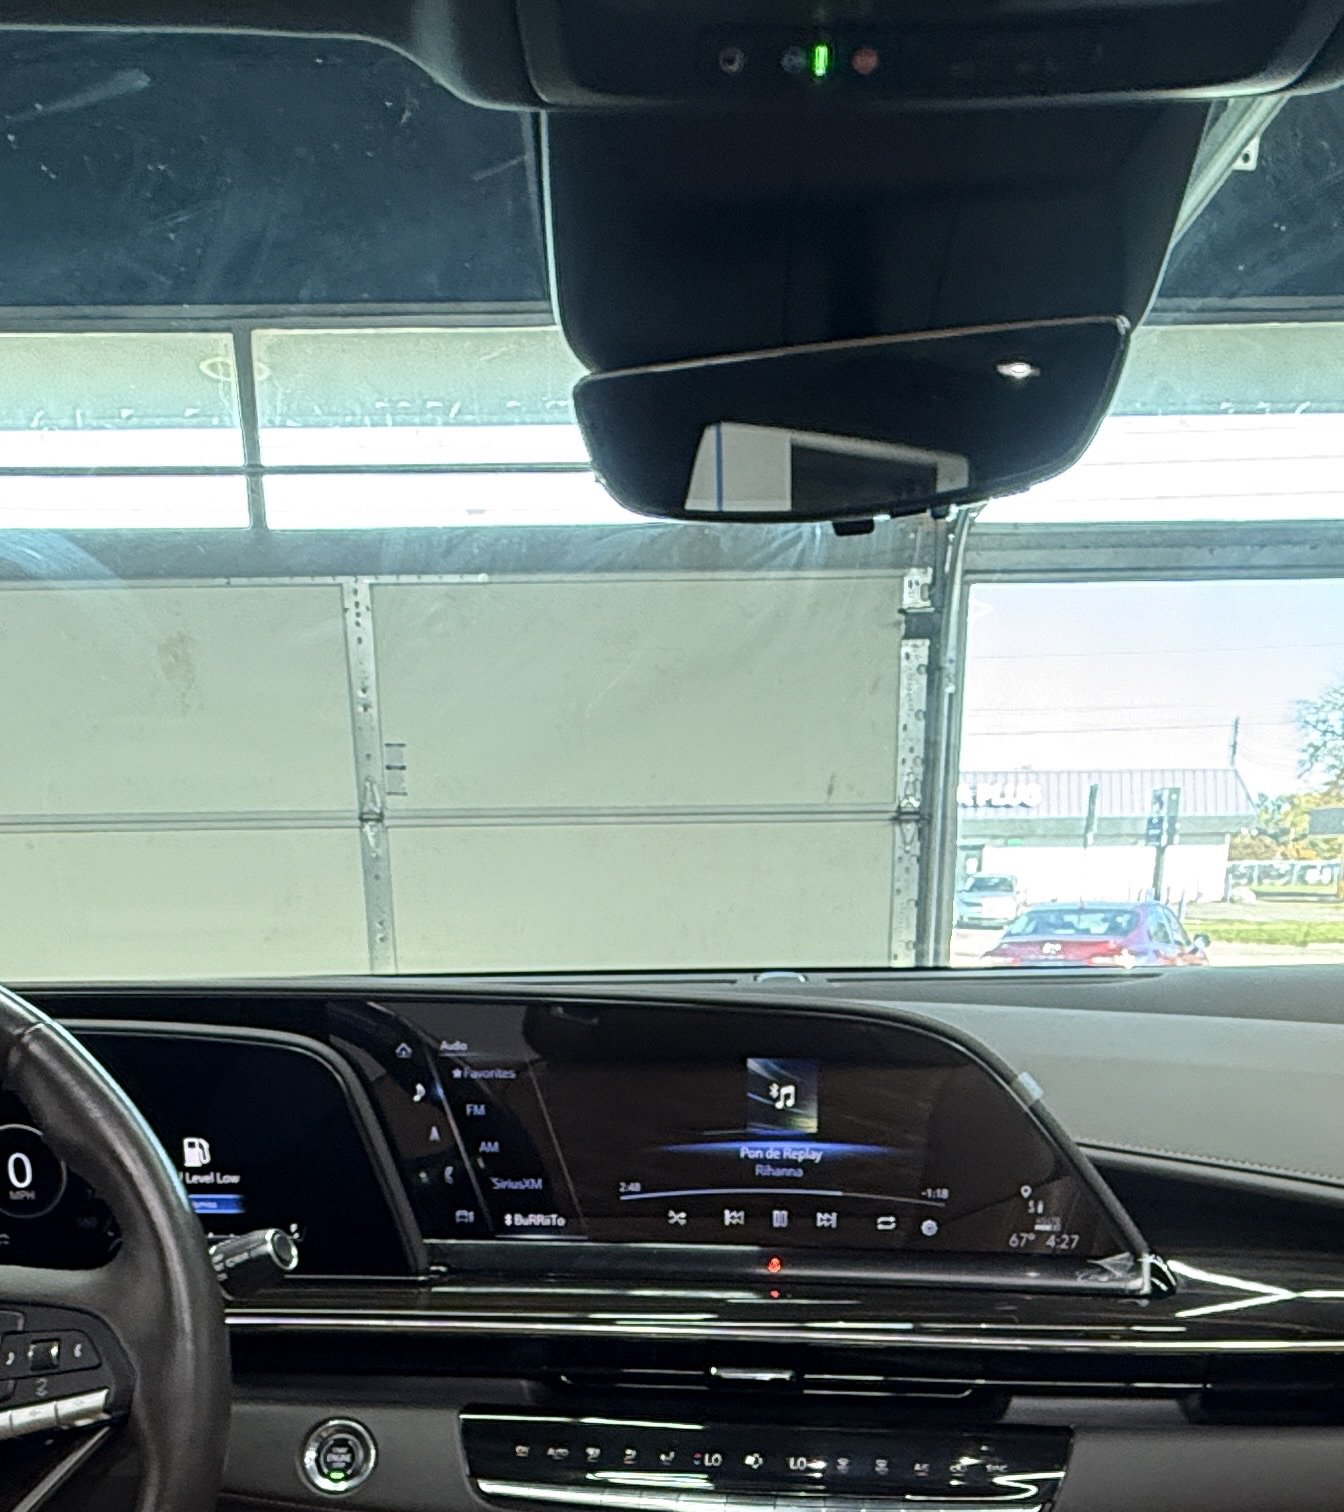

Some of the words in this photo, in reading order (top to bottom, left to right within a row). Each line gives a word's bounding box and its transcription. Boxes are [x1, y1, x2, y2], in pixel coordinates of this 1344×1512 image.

[440, 1040, 468, 1051] Audio
[463, 1068, 517, 1079] Favorites
[466, 1104, 486, 1116] FM
[479, 1141, 500, 1153] AM
[740, 1145, 764, 1159] Pon
[765, 1146, 781, 1160] de
[782, 1147, 823, 1164] Replay
[8, 1152, 33, 1189] 0
[755, 1163, 804, 1177] Rihanna
[185, 1171, 214, 1184] Level
[216, 1172, 241, 1184] Low
[491, 1178, 543, 1190] SiriusXM
[8, 1191, 36, 1201] MPH
[1046, 1233, 1081, 1250] 4:27
[704, 1453, 723, 1467] LO
[789, 1457, 807, 1471] LO
